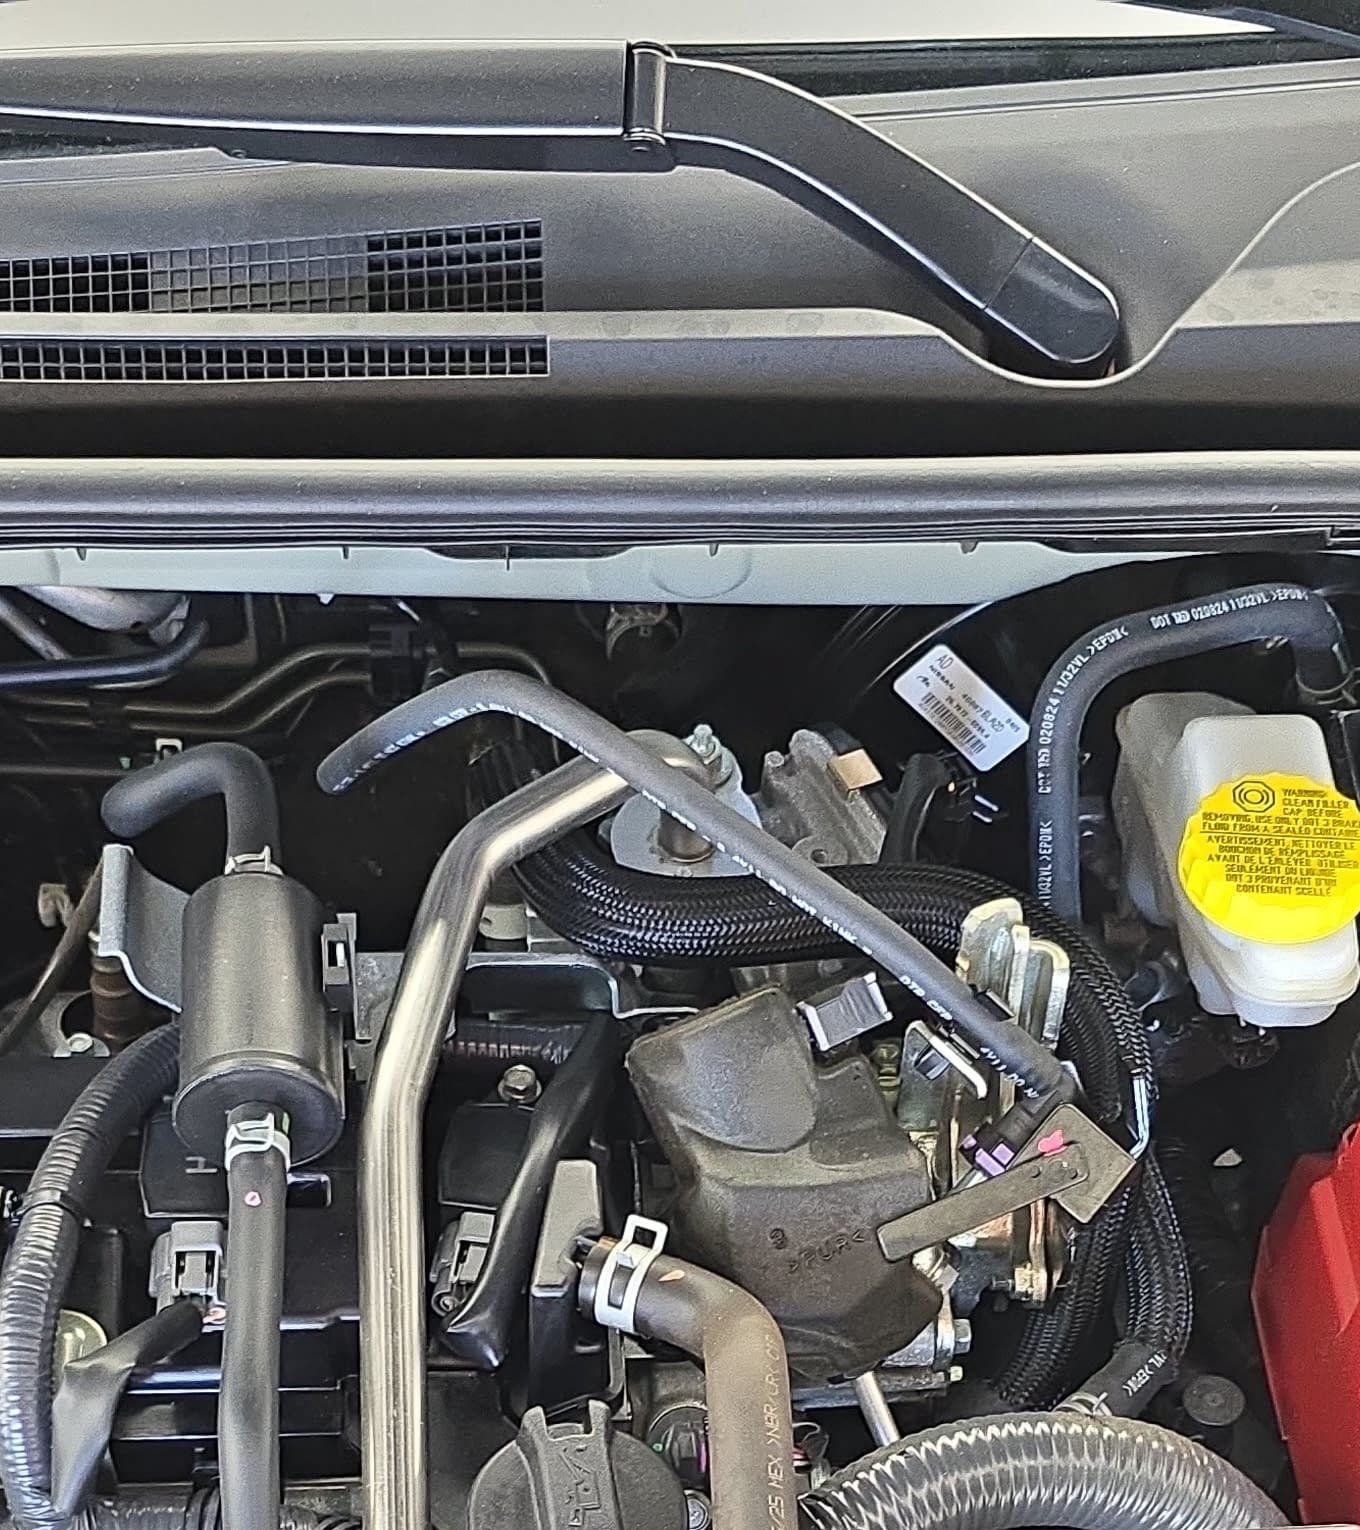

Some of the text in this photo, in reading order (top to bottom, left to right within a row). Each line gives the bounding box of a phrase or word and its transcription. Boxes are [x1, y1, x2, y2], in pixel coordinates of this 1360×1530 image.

[937, 654, 955, 671] AD
[1038, 698, 1061, 746] 020824
[1282, 808, 1303, 817] CAP
[1232, 823, 1259, 833] FROM
[1272, 825, 1311, 836] SEALED
[1207, 853, 1241, 864] AVANT
[1255, 875, 1313, 886] PROVENANT
[1236, 884, 1294, 896] CONTENANT
[766, 1453, 784, 1489] MEX
